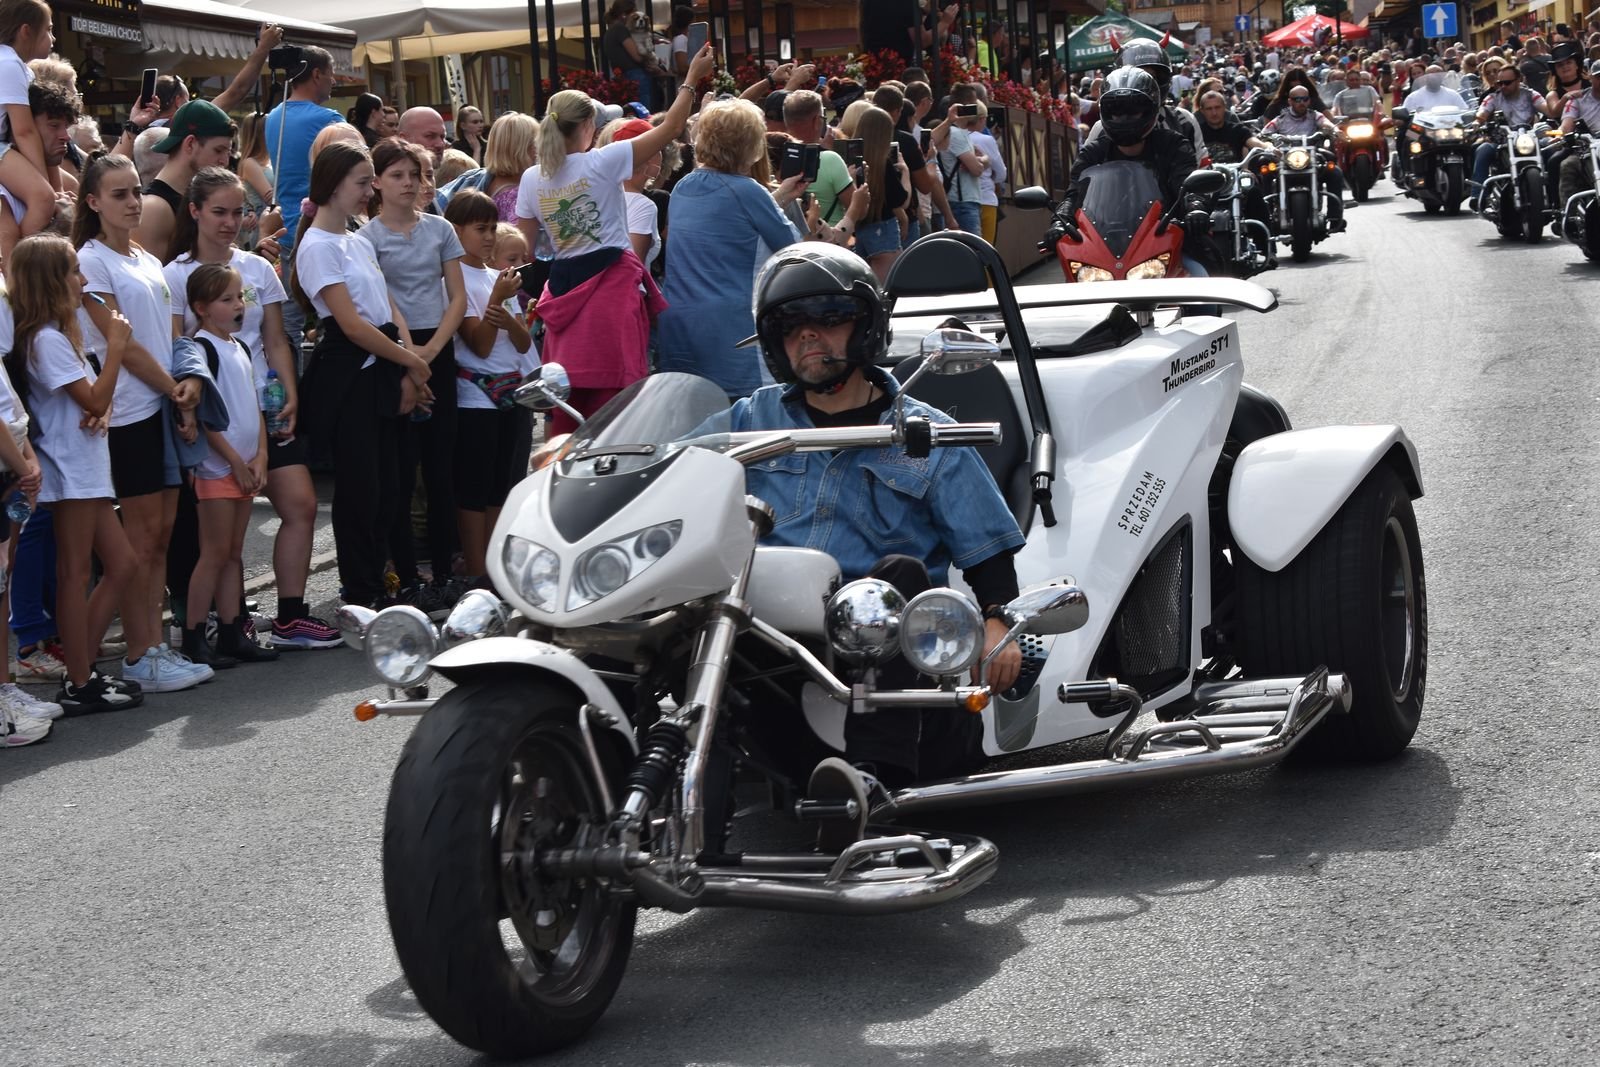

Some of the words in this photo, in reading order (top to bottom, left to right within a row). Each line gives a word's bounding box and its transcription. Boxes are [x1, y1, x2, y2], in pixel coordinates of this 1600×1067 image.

[73, 18, 88, 31] TOP
[88, 21, 117, 37] BELGIAN
[537, 177, 592, 199] SUMMER
[1170, 349, 1209, 377] MUSTANG
[1210, 333, 1229, 355] ST1
[1162, 359, 1216, 393] THUNDERBIRD
[1152, 477, 1166, 494] 555
[1117, 470, 1155, 531] SPRZEDAM
[1145, 491, 1160, 508] 252
[1137, 506, 1152, 523] 601
[1129, 523, 1145, 538] TEL.
